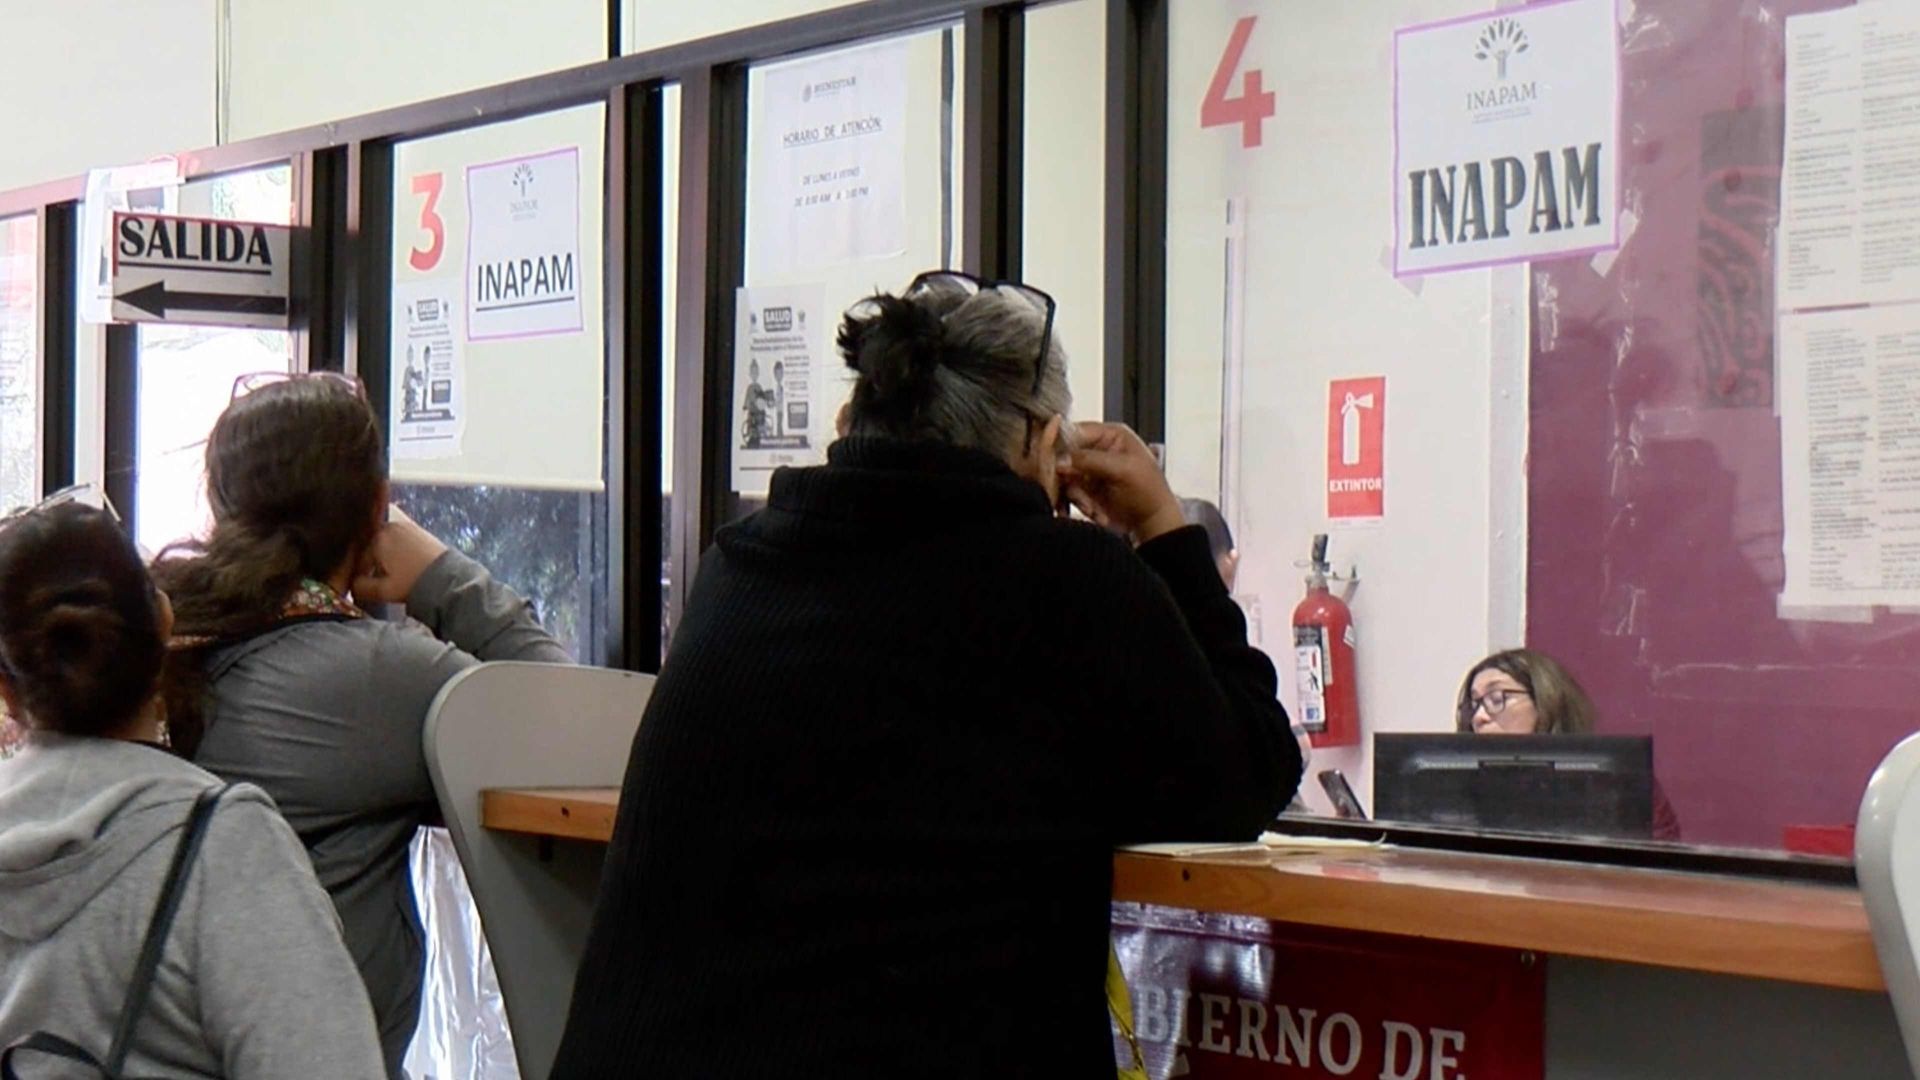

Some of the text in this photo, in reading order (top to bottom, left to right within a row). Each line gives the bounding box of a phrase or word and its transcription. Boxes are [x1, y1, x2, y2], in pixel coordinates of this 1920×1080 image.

[1201, 15, 1275, 148] 4
[1467, 82, 1537, 110] INAPAM
[783, 116, 881, 144] HORARIO DE ATENCIÓN
[1408, 142, 1602, 249] INAPAM
[119, 216, 272, 265] SALIDA
[410, 172, 444, 271] 3
[478, 252, 573, 302] INAPAM
[765, 309, 791, 323] SALUD
[1329, 477, 1382, 492] EXTINTOR
[1135, 984, 1466, 1080] BIERNO DE
